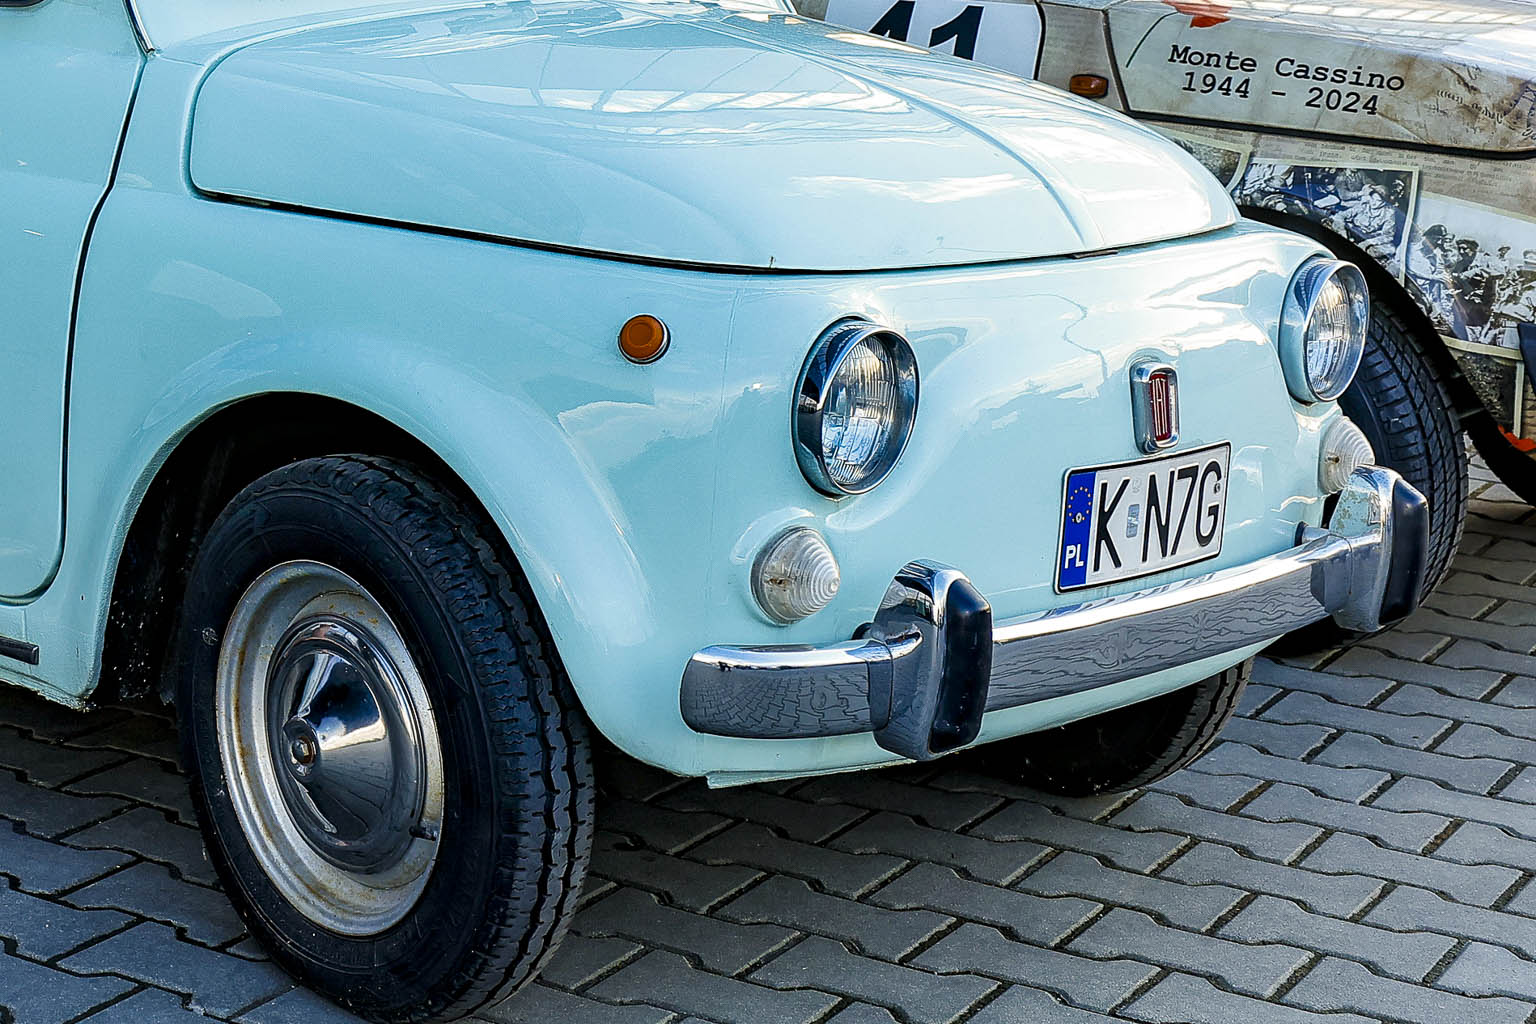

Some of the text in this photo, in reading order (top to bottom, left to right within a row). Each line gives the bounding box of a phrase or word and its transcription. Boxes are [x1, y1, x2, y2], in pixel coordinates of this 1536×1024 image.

[1167, 44, 1405, 92] Monte Cassino
[1182, 71, 1251, 99] 1944
[1305, 87, 1379, 115] 2024
[1064, 544, 1085, 569] PL
